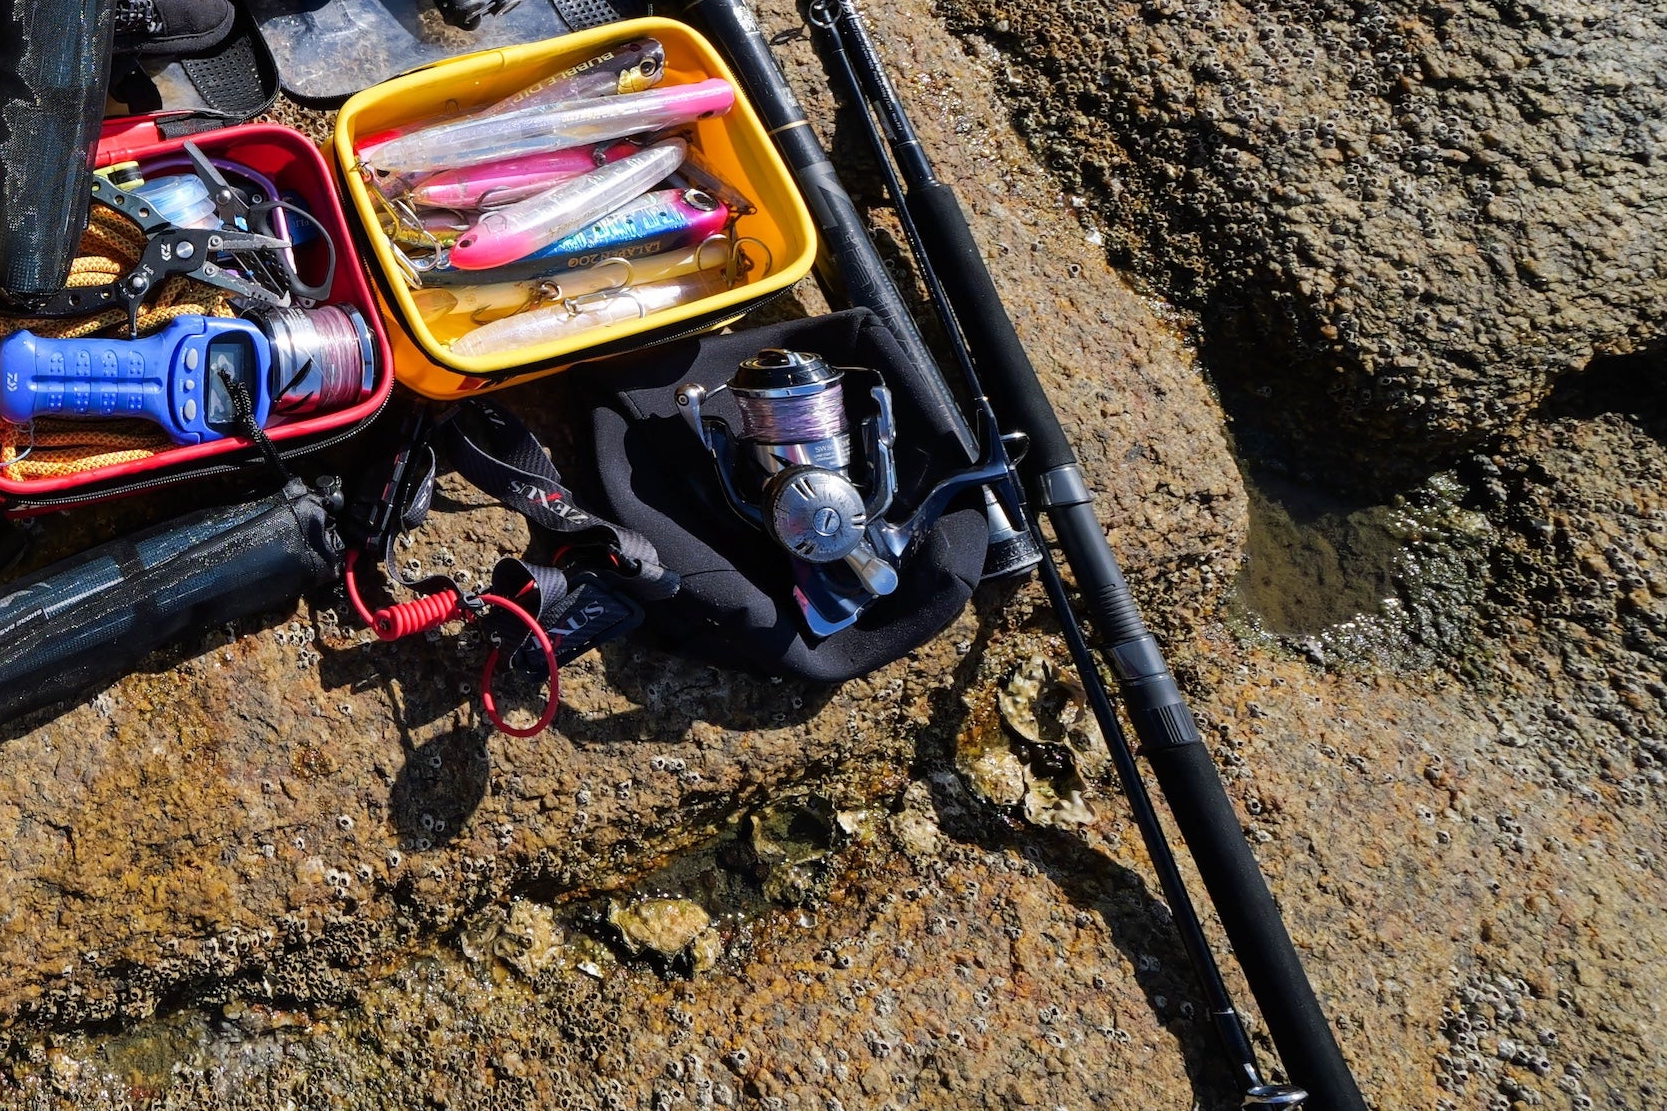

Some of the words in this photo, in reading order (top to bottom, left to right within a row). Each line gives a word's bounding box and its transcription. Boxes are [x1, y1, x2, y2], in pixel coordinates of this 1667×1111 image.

[547, 51, 615, 87] BUBBLE
[512, 82, 544, 104] DIP
[508, 479, 589, 525] ZEXUS
[16, 608, 43, 628] SHORE
